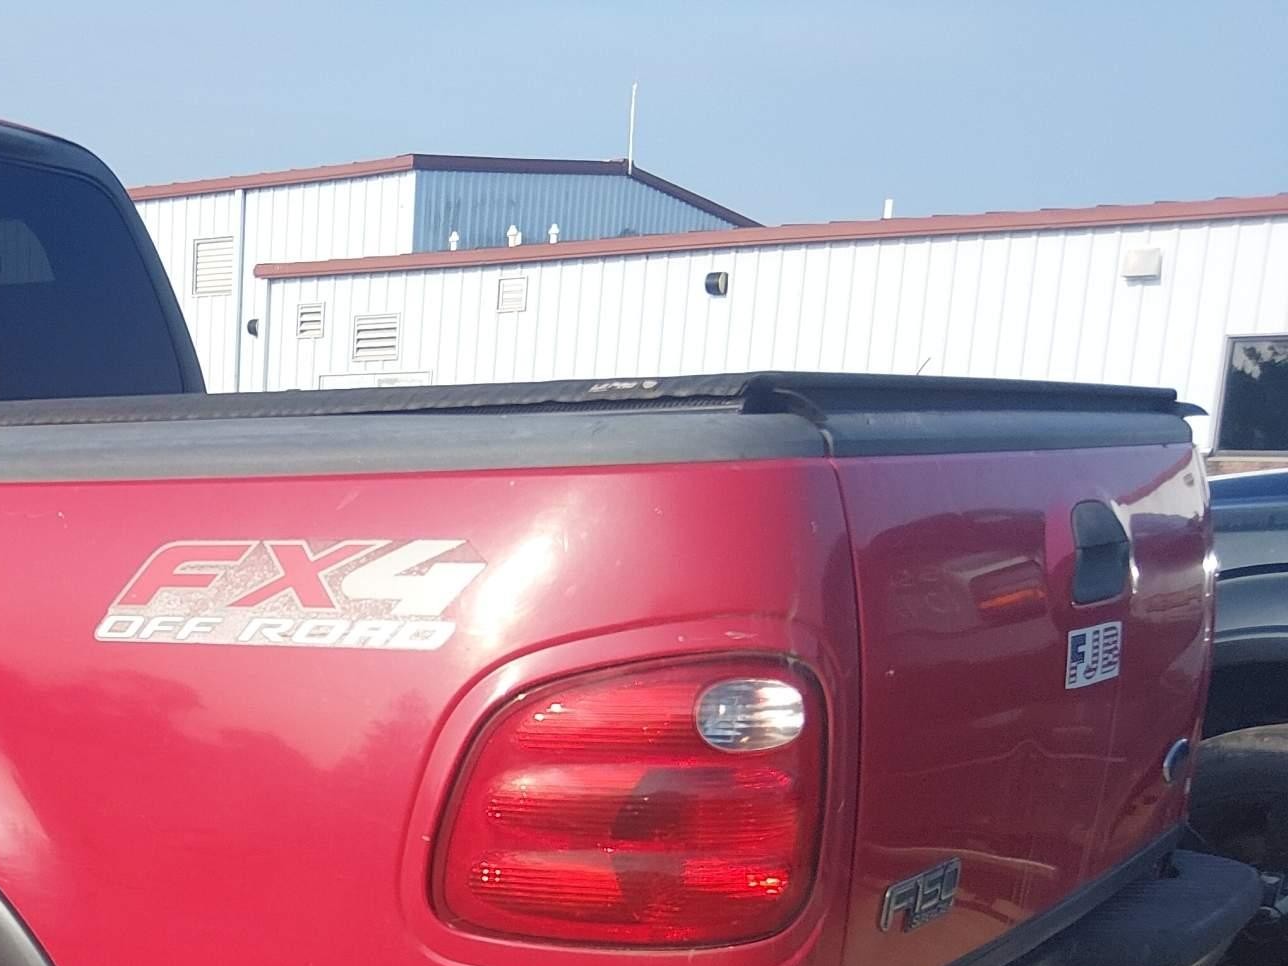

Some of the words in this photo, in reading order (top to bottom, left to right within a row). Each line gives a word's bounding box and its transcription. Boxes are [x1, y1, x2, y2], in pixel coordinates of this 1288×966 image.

[109, 539, 488, 616] FX4
[97, 615, 223, 640] OFF
[238, 616, 457, 650] ROAD
